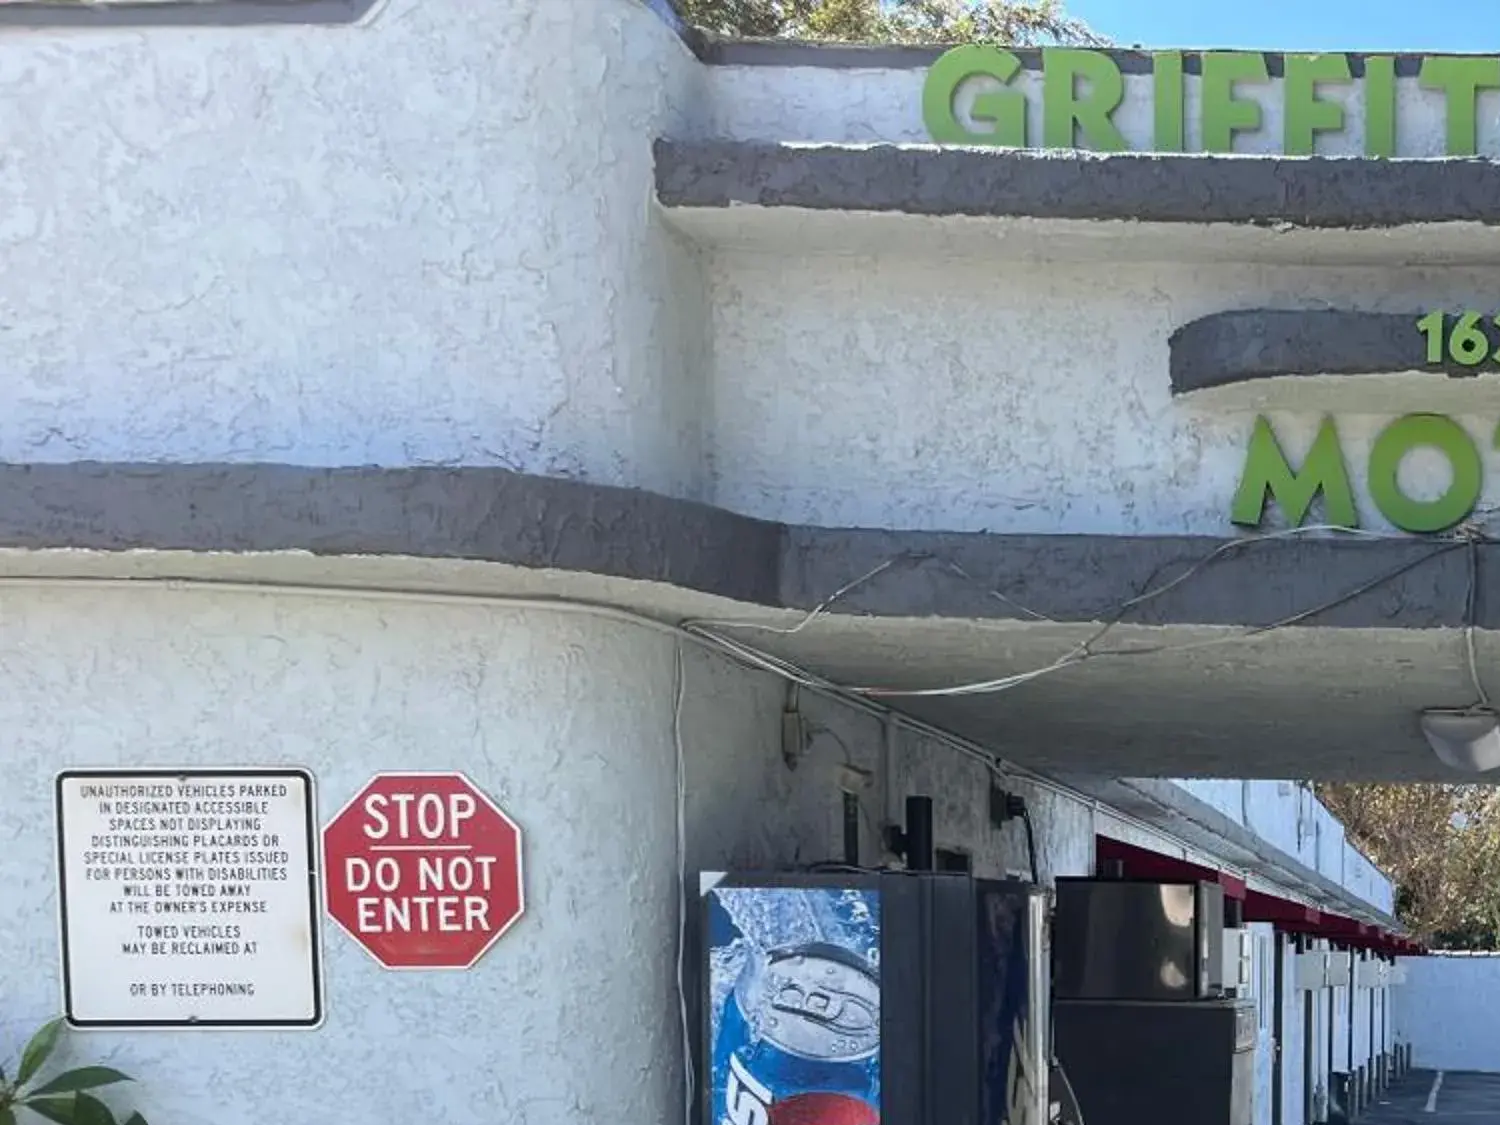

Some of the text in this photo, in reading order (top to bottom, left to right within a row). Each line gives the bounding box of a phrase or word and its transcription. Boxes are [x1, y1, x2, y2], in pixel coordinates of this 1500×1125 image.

[81, 785, 287, 797] UNAUTHORIZED VEHICLES PARKED
[99, 802, 268, 814] IN DESIGNATED ACCESSIBLE
[363, 793, 476, 839] STOP
[109, 818, 261, 830] SPACES NOT DISPLAYING
[92, 835, 279, 847] DISTINGUISHING PLACARDS OR
[84, 851, 288, 864] SPECIAL LICENSE PLATES ISSUED
[86, 868, 287, 880] FOR PERSONS WITH DISABILITIES
[346, 856, 496, 892] DO NOT
[124, 884, 251, 897] WILL BE TOWED AWAY
[110, 901, 267, 913] AT THE OWNER'S EXPENSE
[357, 896, 490, 932] ENTER
[138, 926, 240, 938] TOWED VEHICLES
[122, 942, 257, 955] MAY BE RECLAIMED AT
[130, 984, 255, 996] OR BY TELEPHONING
